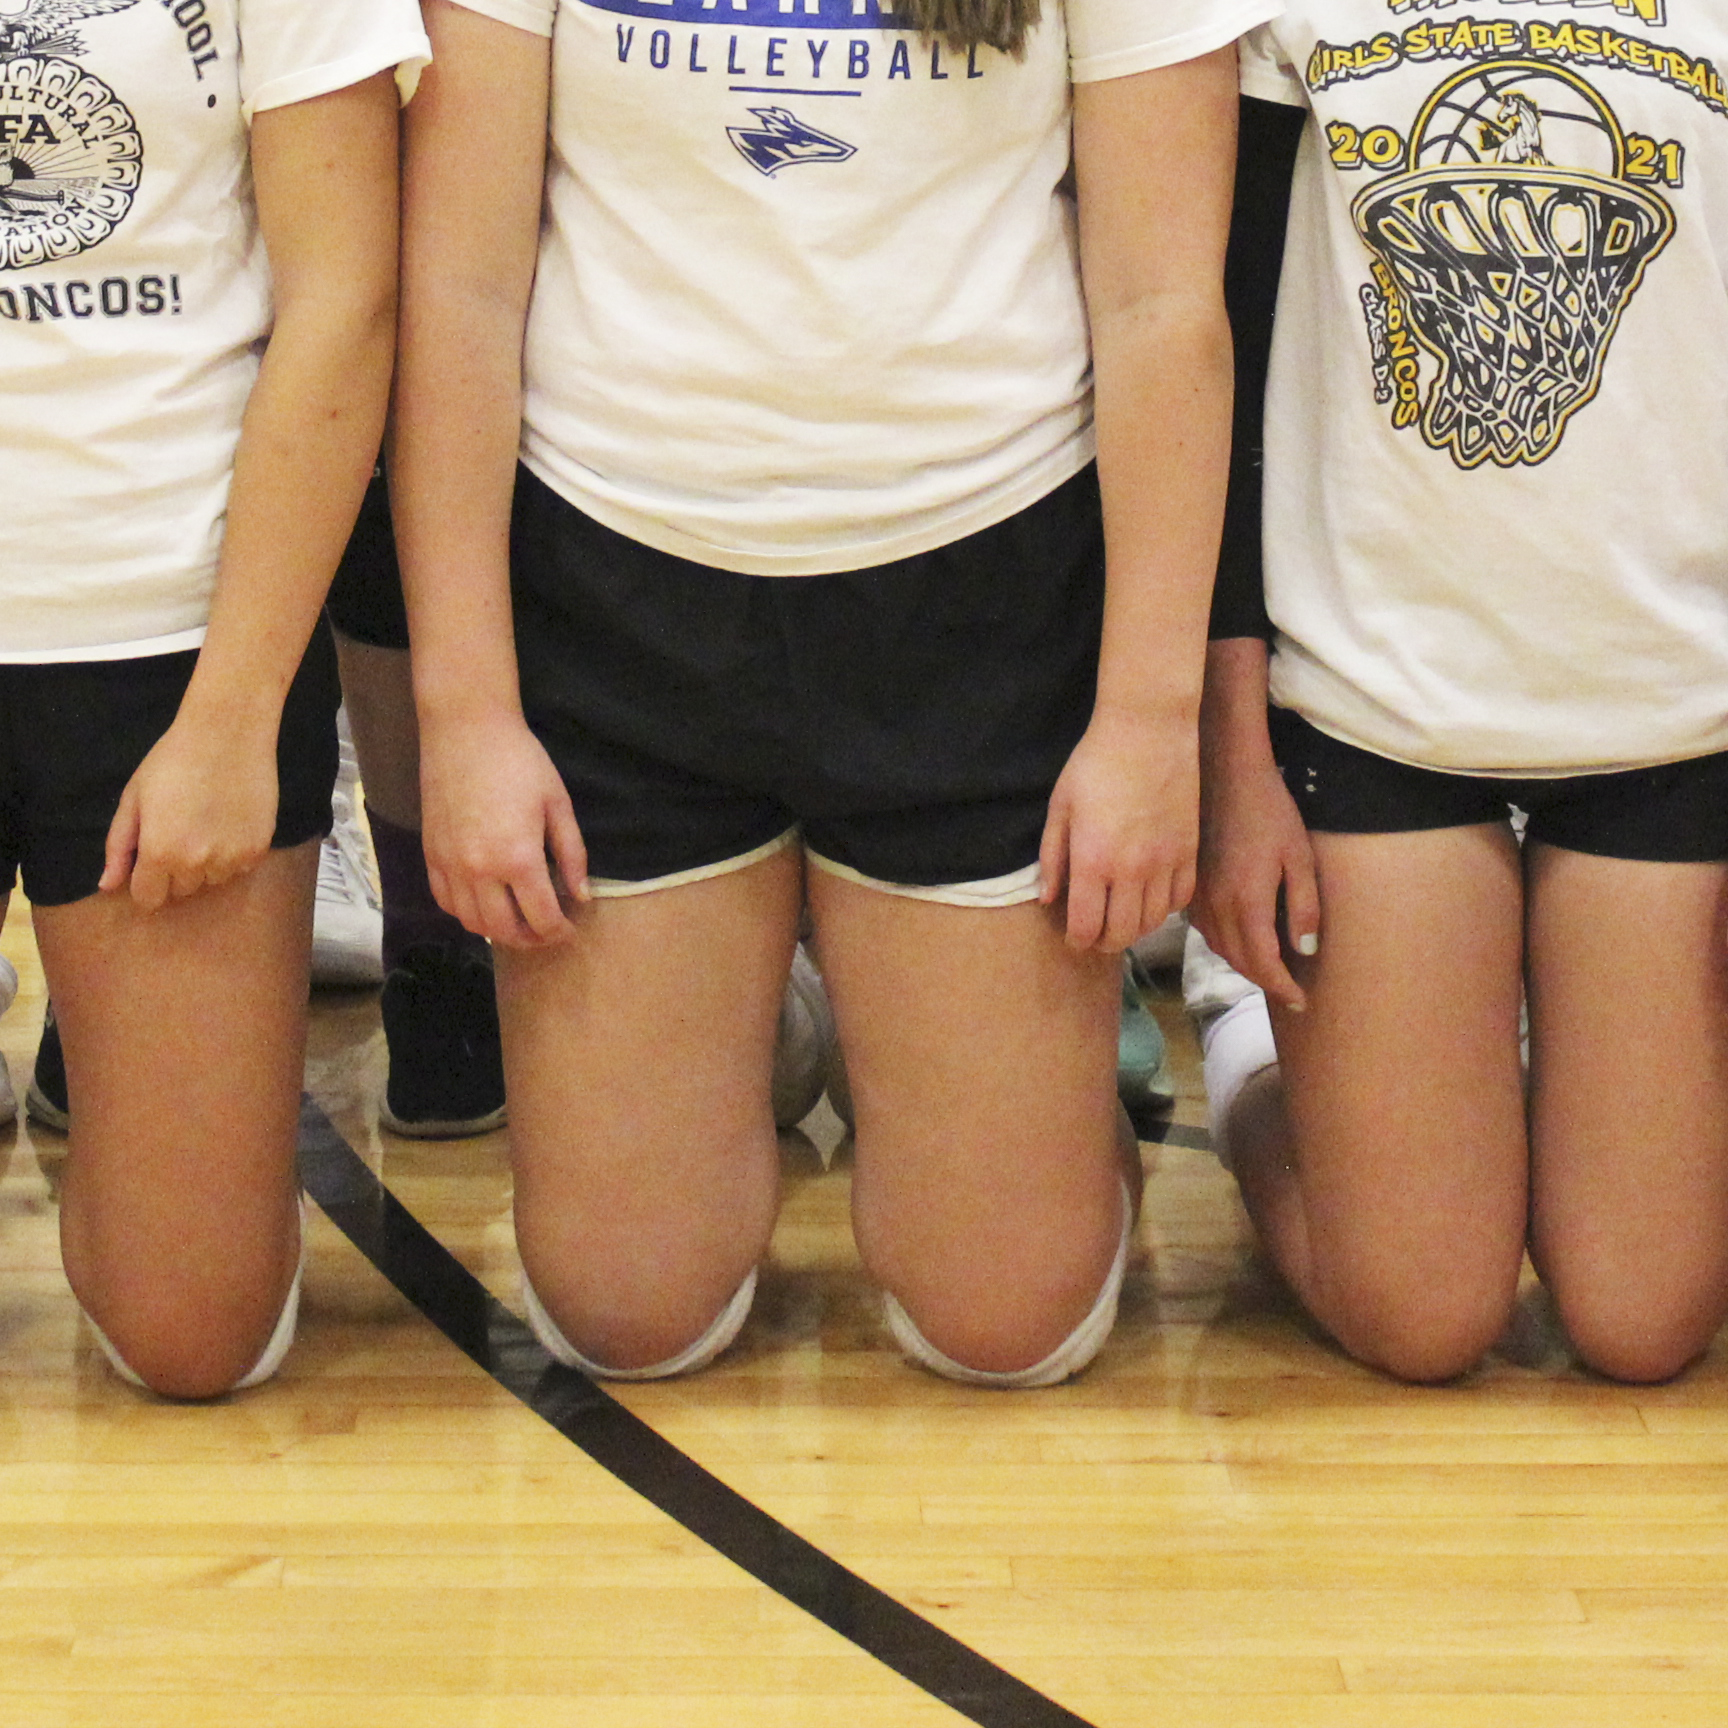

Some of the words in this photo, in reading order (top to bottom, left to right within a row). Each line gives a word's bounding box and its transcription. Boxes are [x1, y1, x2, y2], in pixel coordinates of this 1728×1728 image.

[616, 23, 985, 81] VOLLEYBALL
[1305, 31, 1403, 94] GIRLS
[1403, 17, 1522, 61] STATE
[1328, 119, 1406, 170] 20
[1623, 132, 1685, 188] 21
[1358, 282, 1388, 360] CLASS
[1369, 257, 1422, 430] BRONCOS
